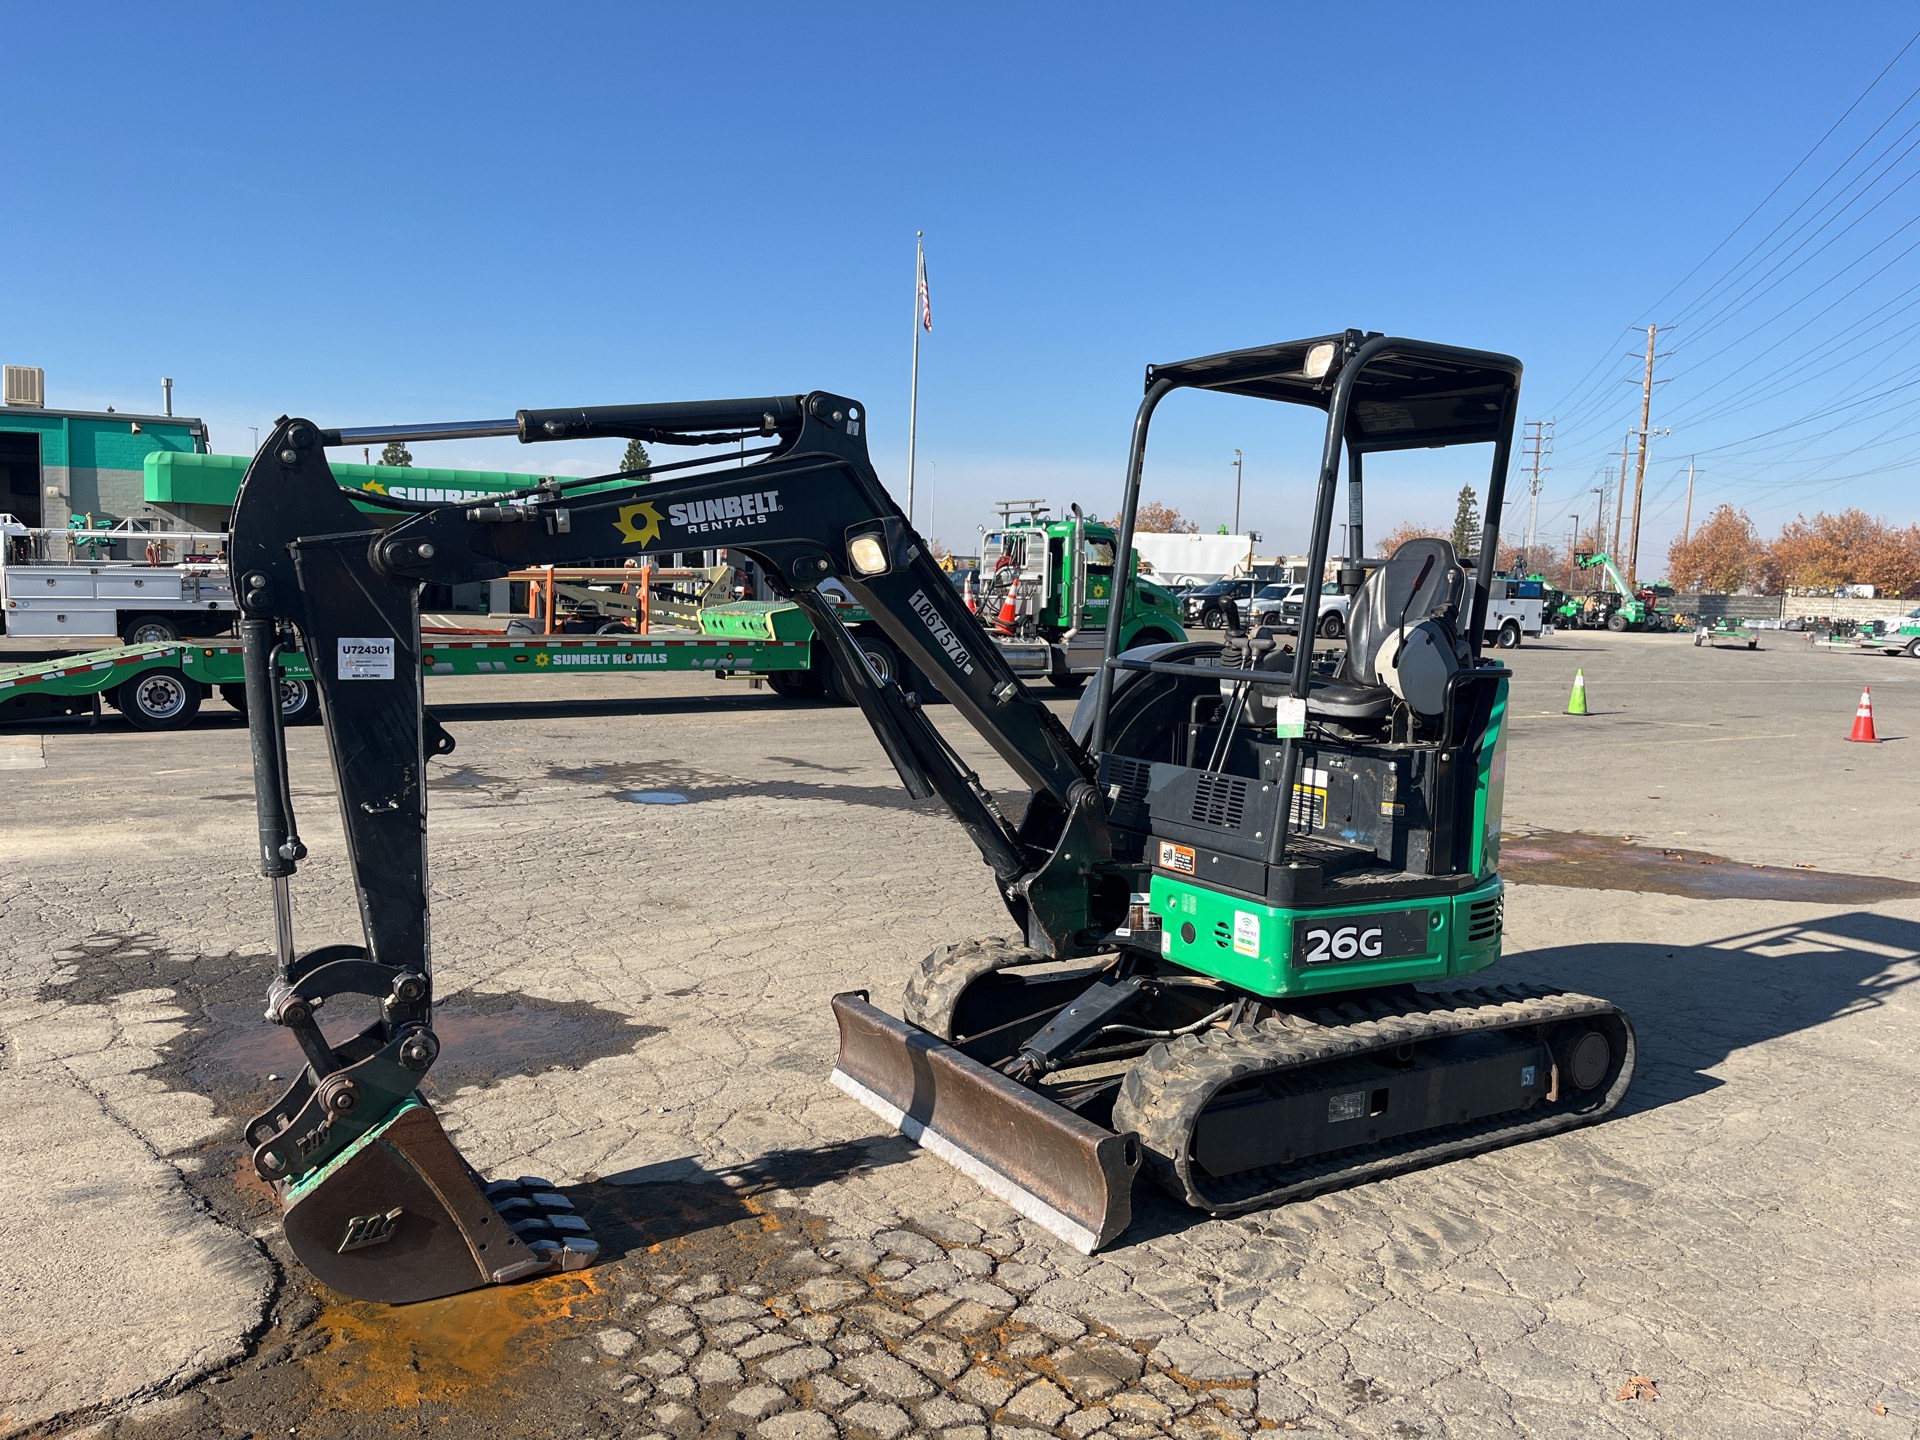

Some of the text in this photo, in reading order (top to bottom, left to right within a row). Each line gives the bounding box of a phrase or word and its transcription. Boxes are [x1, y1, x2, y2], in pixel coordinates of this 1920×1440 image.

[668, 490, 779, 527] SUNBELT
[687, 514, 767, 534] RENTALS
[912, 593, 970, 665] 1067570
[342, 645, 390, 654] U724301
[552, 653, 668, 665] SUNBELT RENTALS
[1306, 927, 1382, 962] 26G
